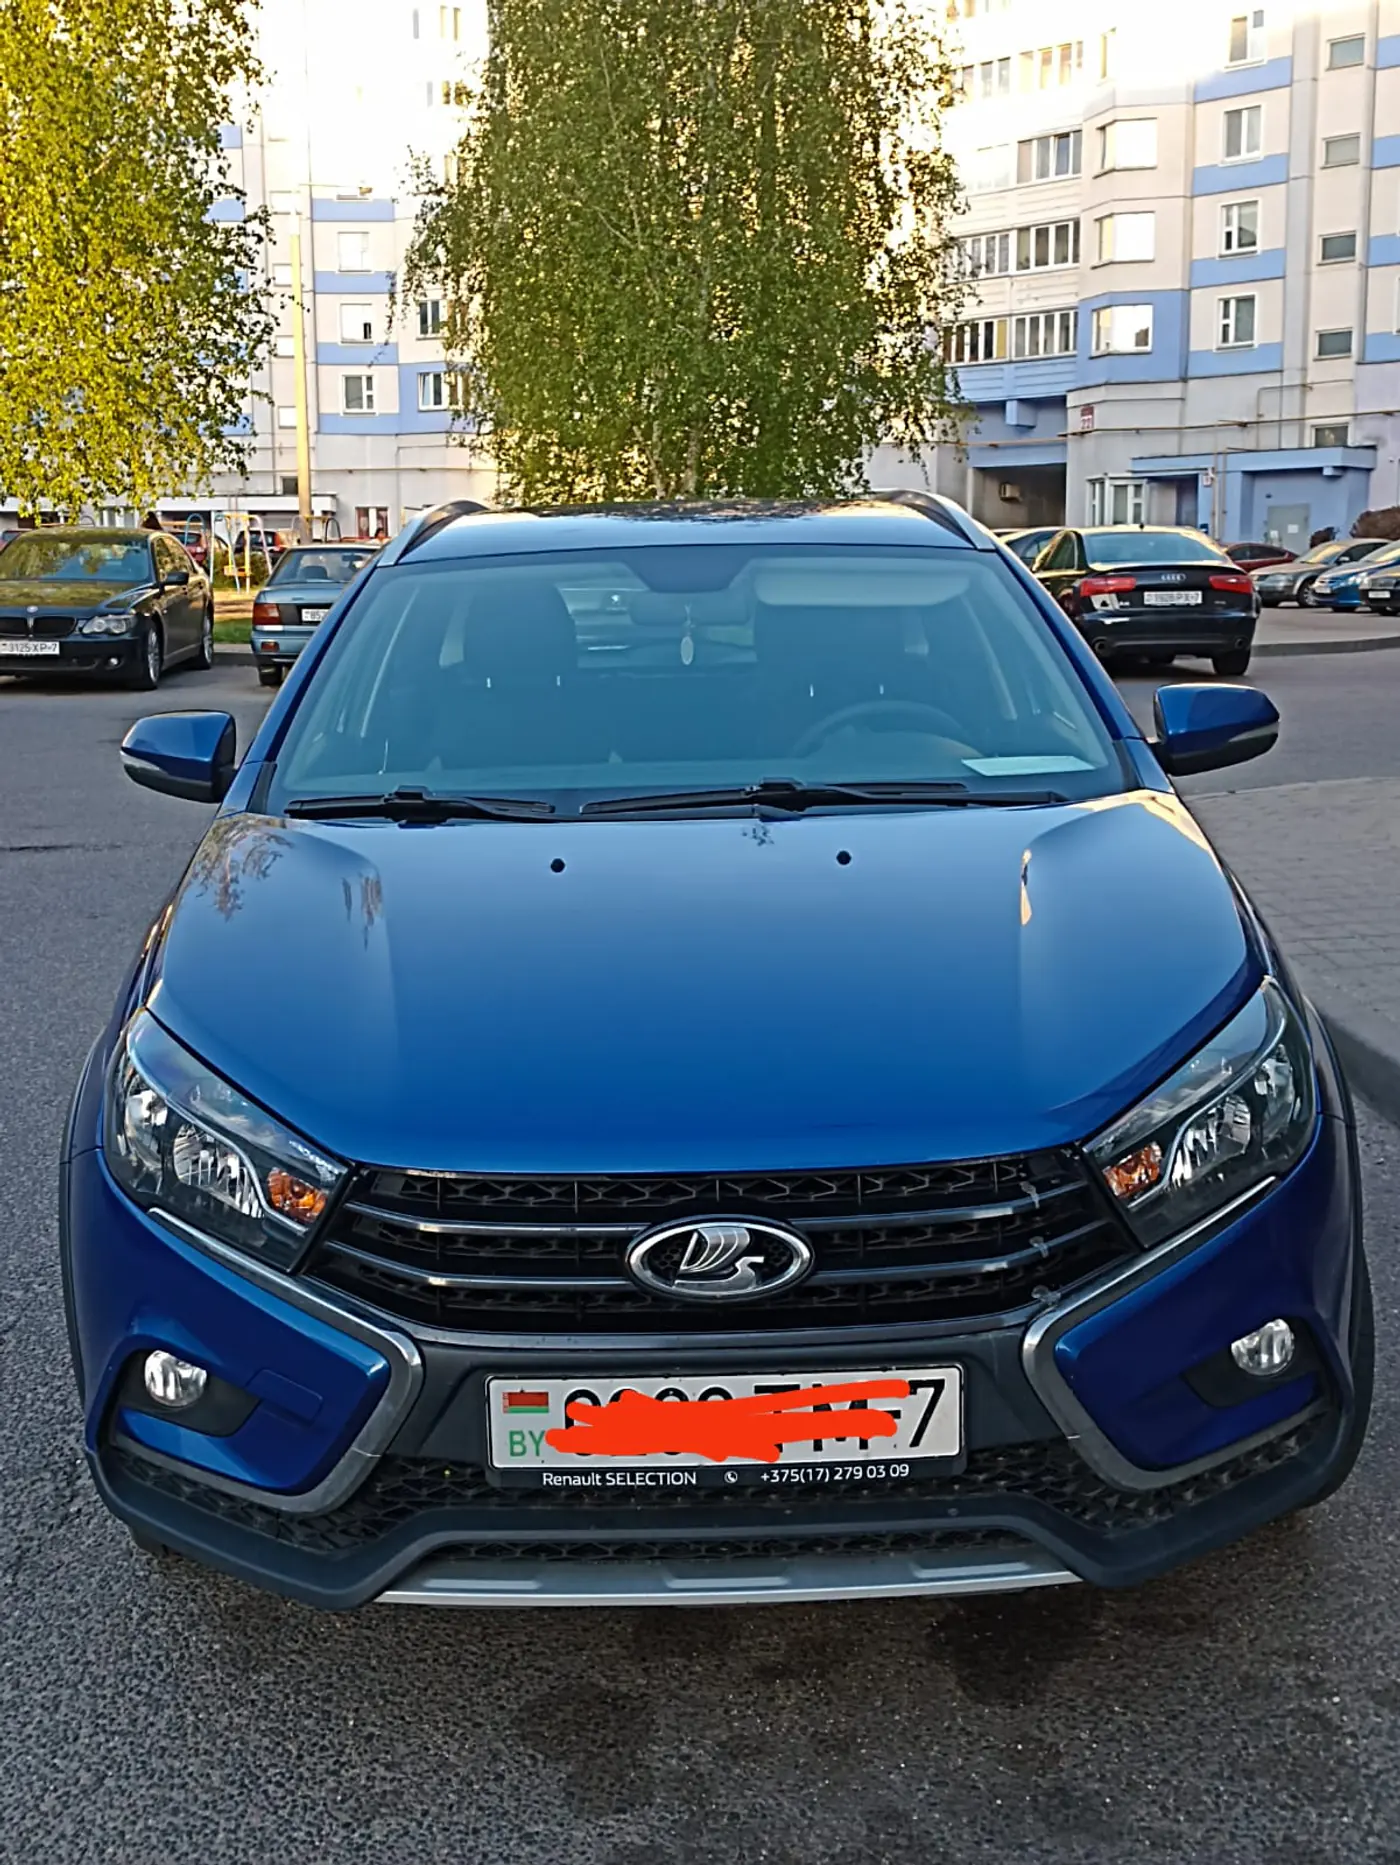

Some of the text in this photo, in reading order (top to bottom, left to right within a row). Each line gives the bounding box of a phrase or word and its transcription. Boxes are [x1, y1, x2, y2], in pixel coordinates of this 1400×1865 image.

[509, 1430, 545, 1457] BY
[543, 1464, 910, 1486] Renault SELECTION +375(17) 279 03 09
